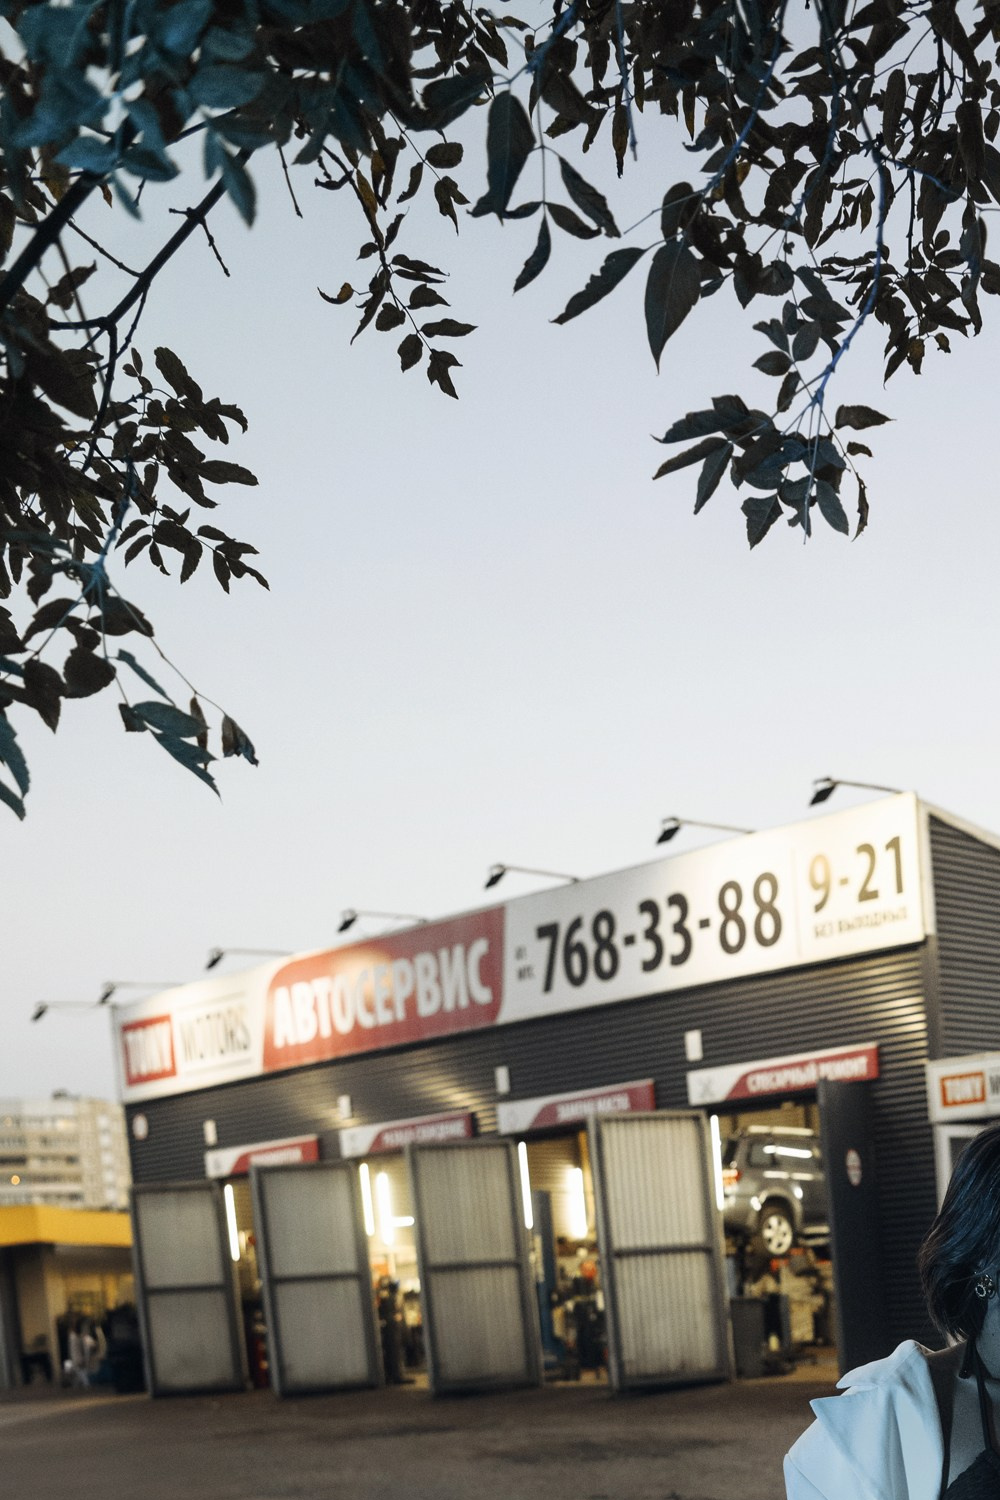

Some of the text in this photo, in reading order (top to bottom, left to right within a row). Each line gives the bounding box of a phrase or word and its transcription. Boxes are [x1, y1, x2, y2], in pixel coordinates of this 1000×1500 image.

[809, 835, 905, 914] 9-21
[536, 871, 783, 993] 768-33-88
[273, 937, 493, 1049] АВТОСЕРВИС
[180, 1005, 251, 1064] MOTORS
[943, 1076, 983, 1104] TONY
